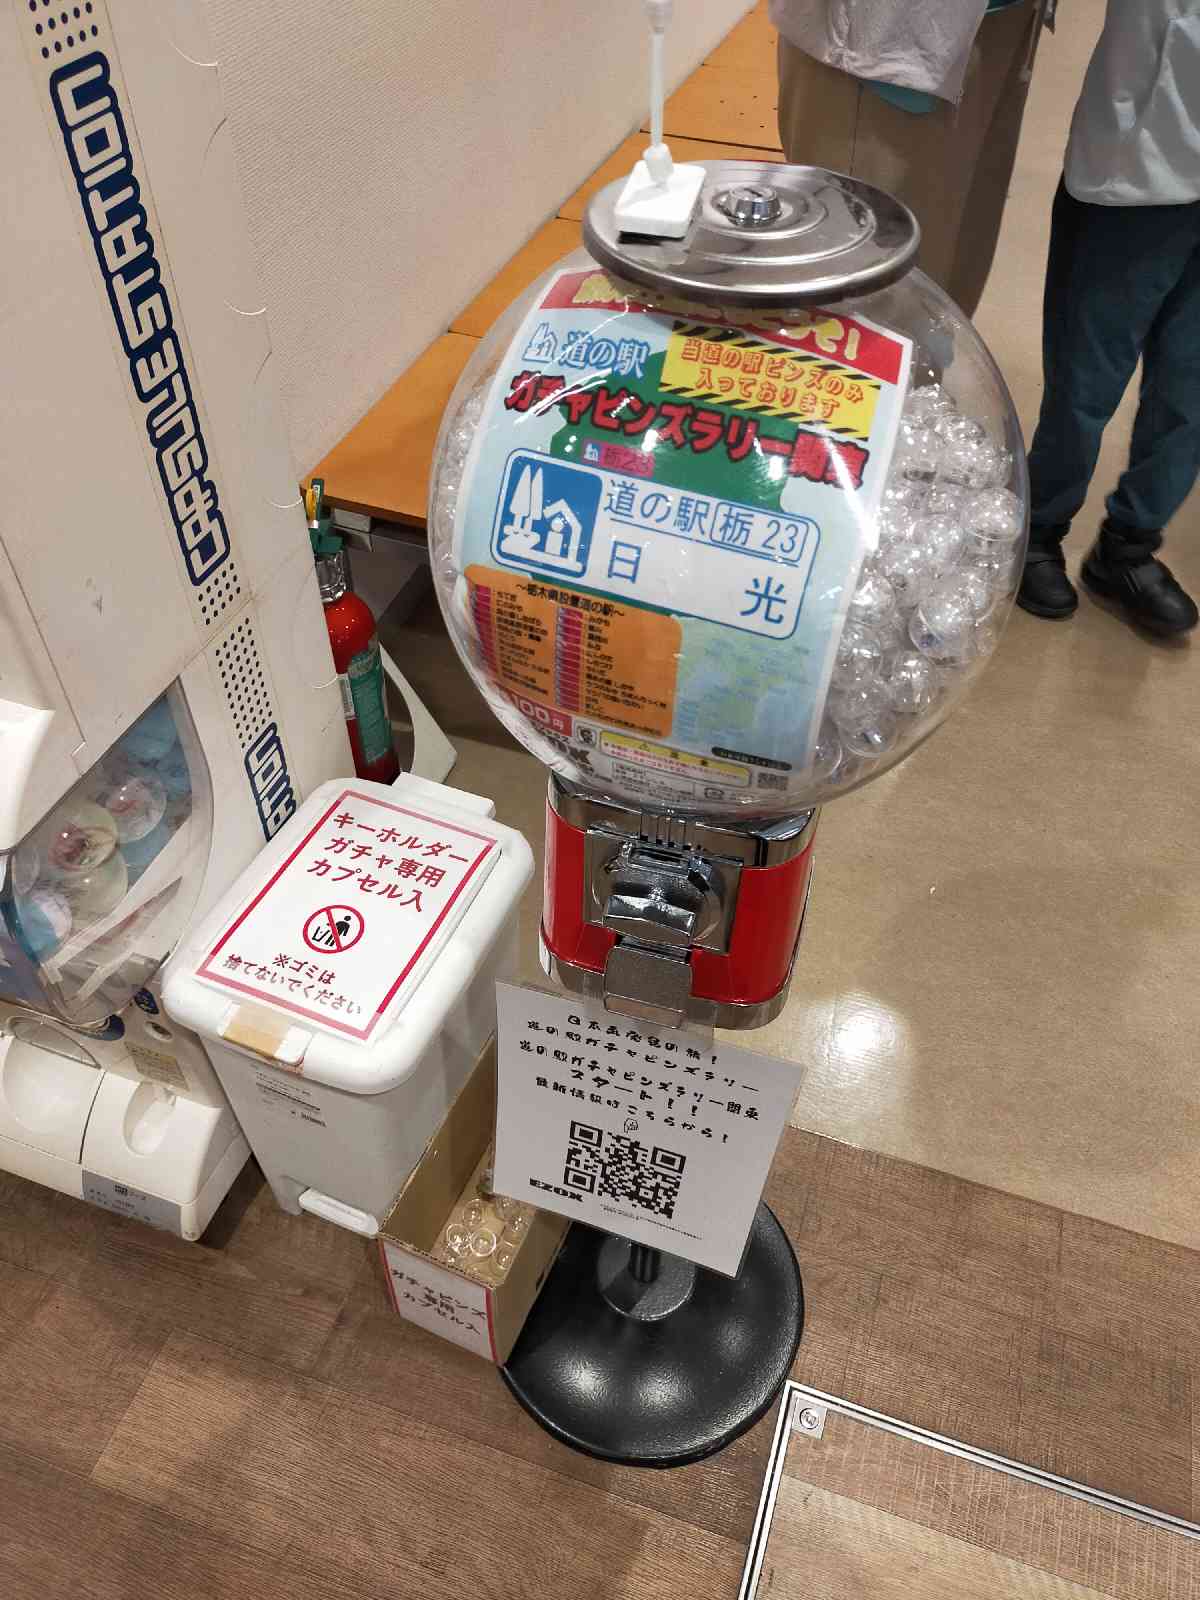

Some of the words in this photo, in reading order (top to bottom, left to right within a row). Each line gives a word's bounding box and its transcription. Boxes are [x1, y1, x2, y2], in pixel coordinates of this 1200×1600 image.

[53, 55, 173, 353] STATION
[560, 331, 649, 379] 道の駅
[696, 368, 840, 418] 入っております
[132, 337, 229, 582] CAPSULE
[603, 479, 711, 536] 道の駅
[324, 837, 446, 888] ガチャ専用
[333, 812, 469, 863] キーホルダー
[306, 858, 422, 912] カプセル入
[221, 953, 362, 1015] 捨てないでください
[272, 952, 336, 985] ※ゴミは
[519, 1039, 760, 1121] 道の駅ガチャピンズラリー関東
[527, 1020, 760, 1093] 道の駅ガチャピンズラリー
